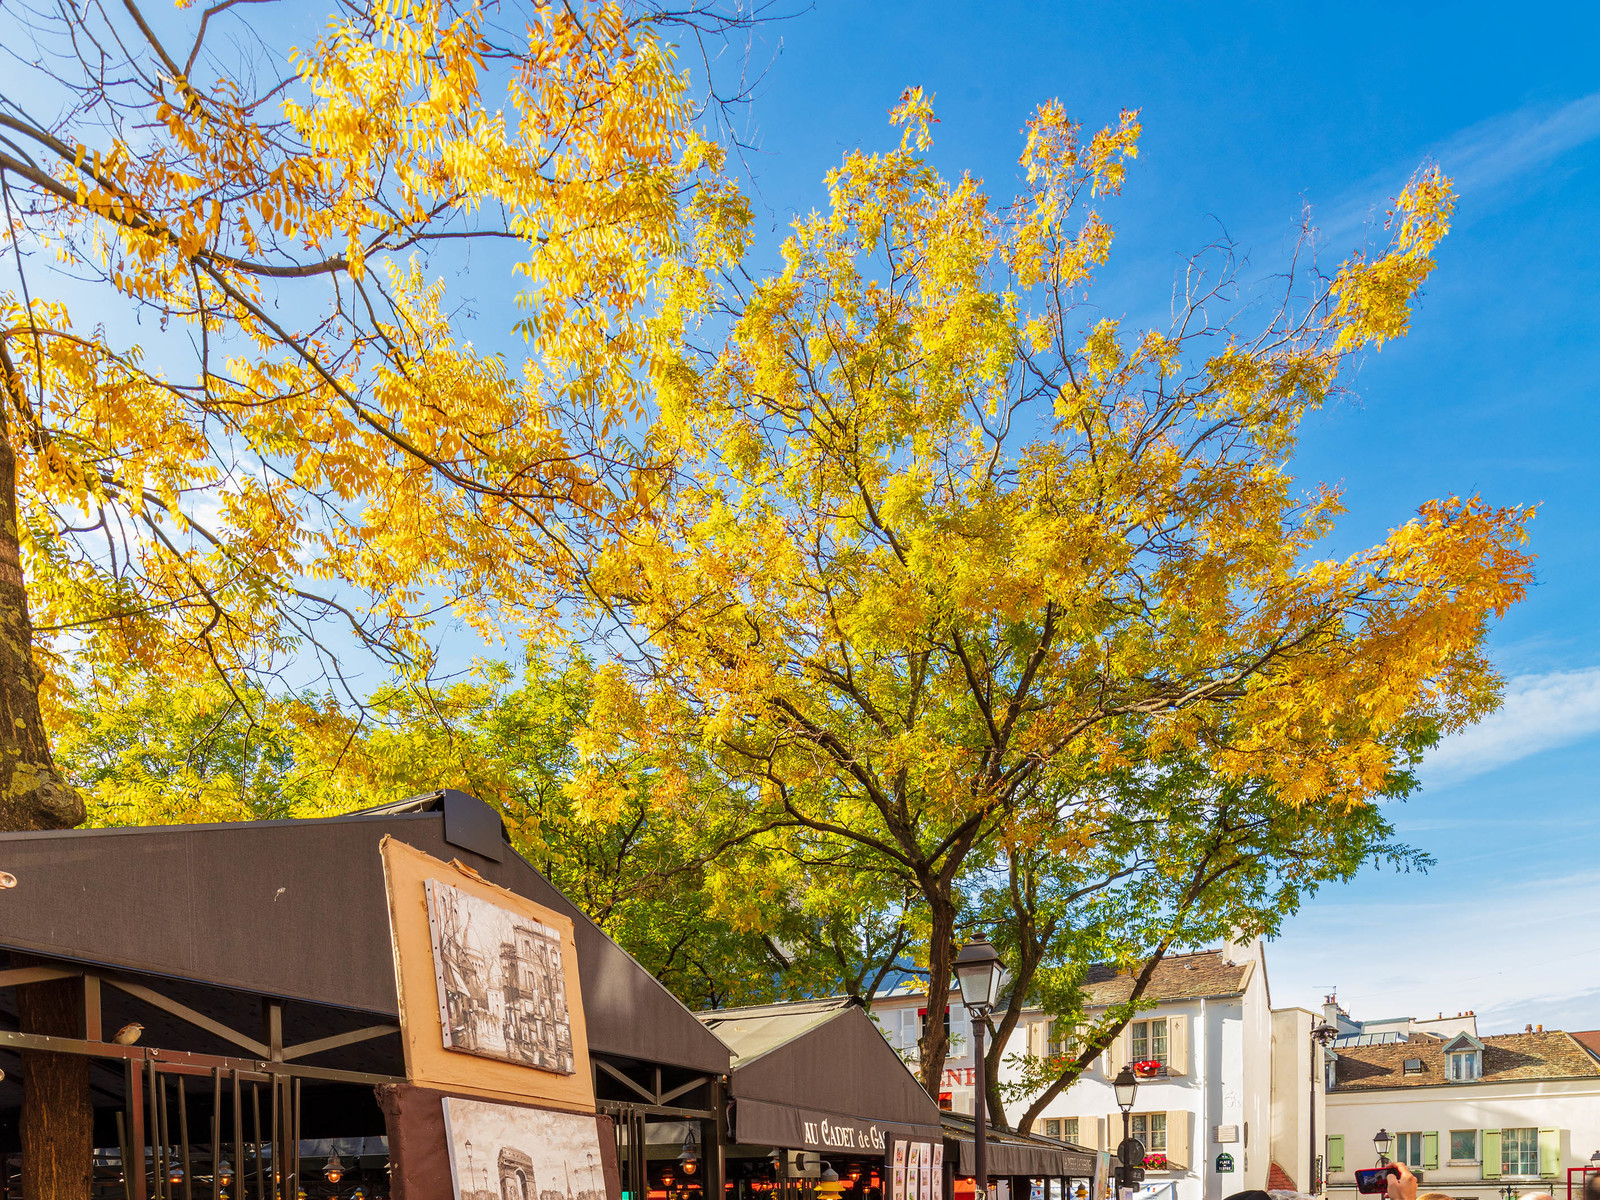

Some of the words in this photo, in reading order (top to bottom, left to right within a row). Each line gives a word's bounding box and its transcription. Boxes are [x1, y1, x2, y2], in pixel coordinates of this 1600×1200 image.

[804, 1121, 819, 1145] AU
[821, 1118, 855, 1148] CADET
[858, 1130, 870, 1148] de
[870, 1125, 886, 1149] GA
